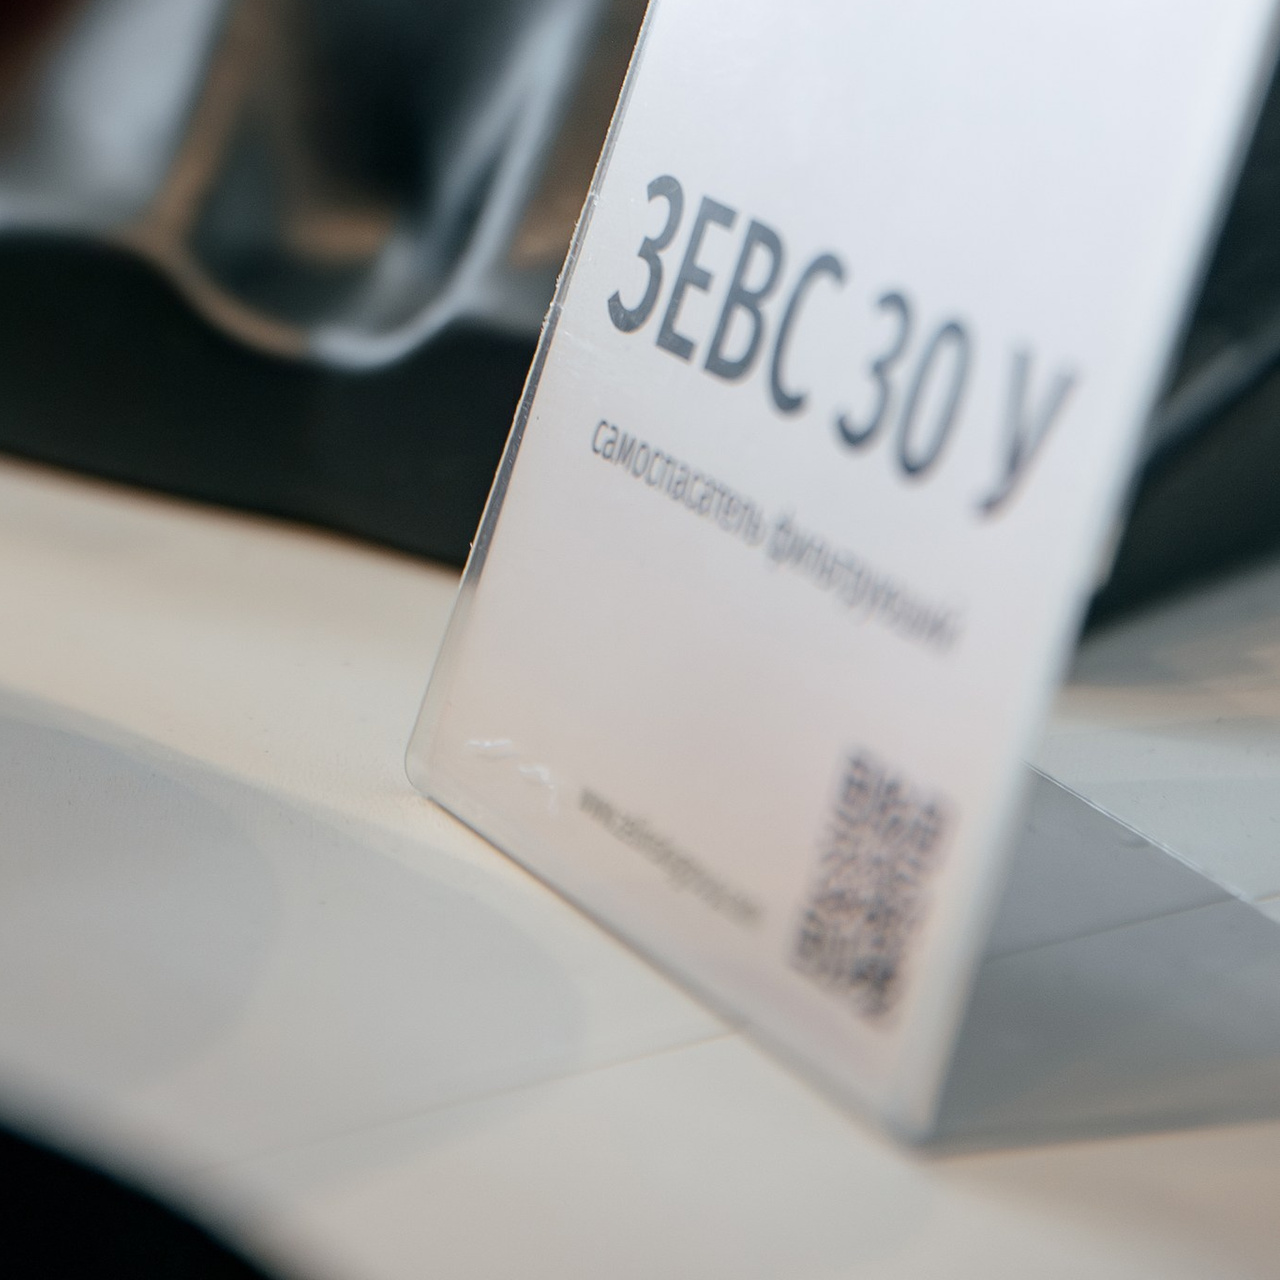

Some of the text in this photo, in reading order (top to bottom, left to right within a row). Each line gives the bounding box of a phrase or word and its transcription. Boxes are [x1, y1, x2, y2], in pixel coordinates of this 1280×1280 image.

[607, 174, 1080, 522] ЗЕВС 30 У
[591, 419, 765, 547] самоспасатель
